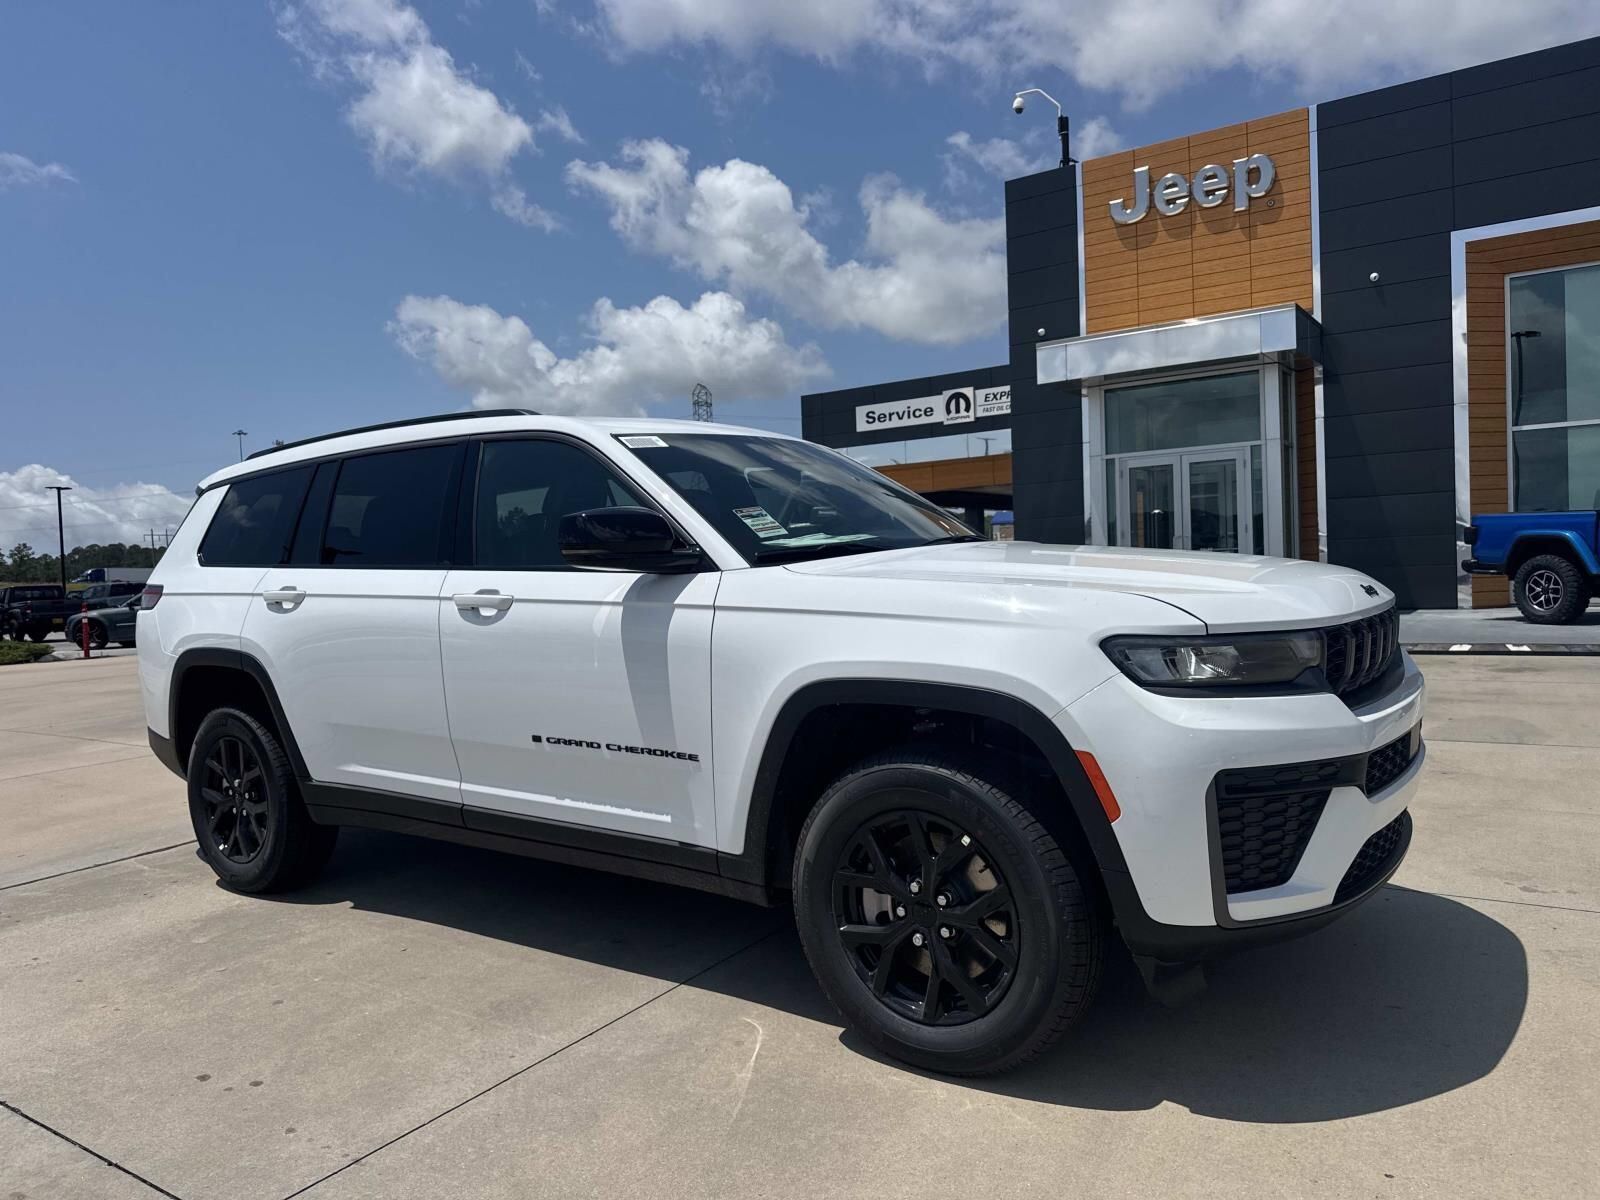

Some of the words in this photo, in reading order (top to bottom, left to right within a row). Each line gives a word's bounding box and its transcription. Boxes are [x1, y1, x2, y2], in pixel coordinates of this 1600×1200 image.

[1109, 153, 1276, 225] Jeep
[865, 406, 934, 425] Service
[982, 406, 996, 414] FAST
[546, 736, 601, 750] GRAND
[605, 743, 700, 762] CHEROKEE
